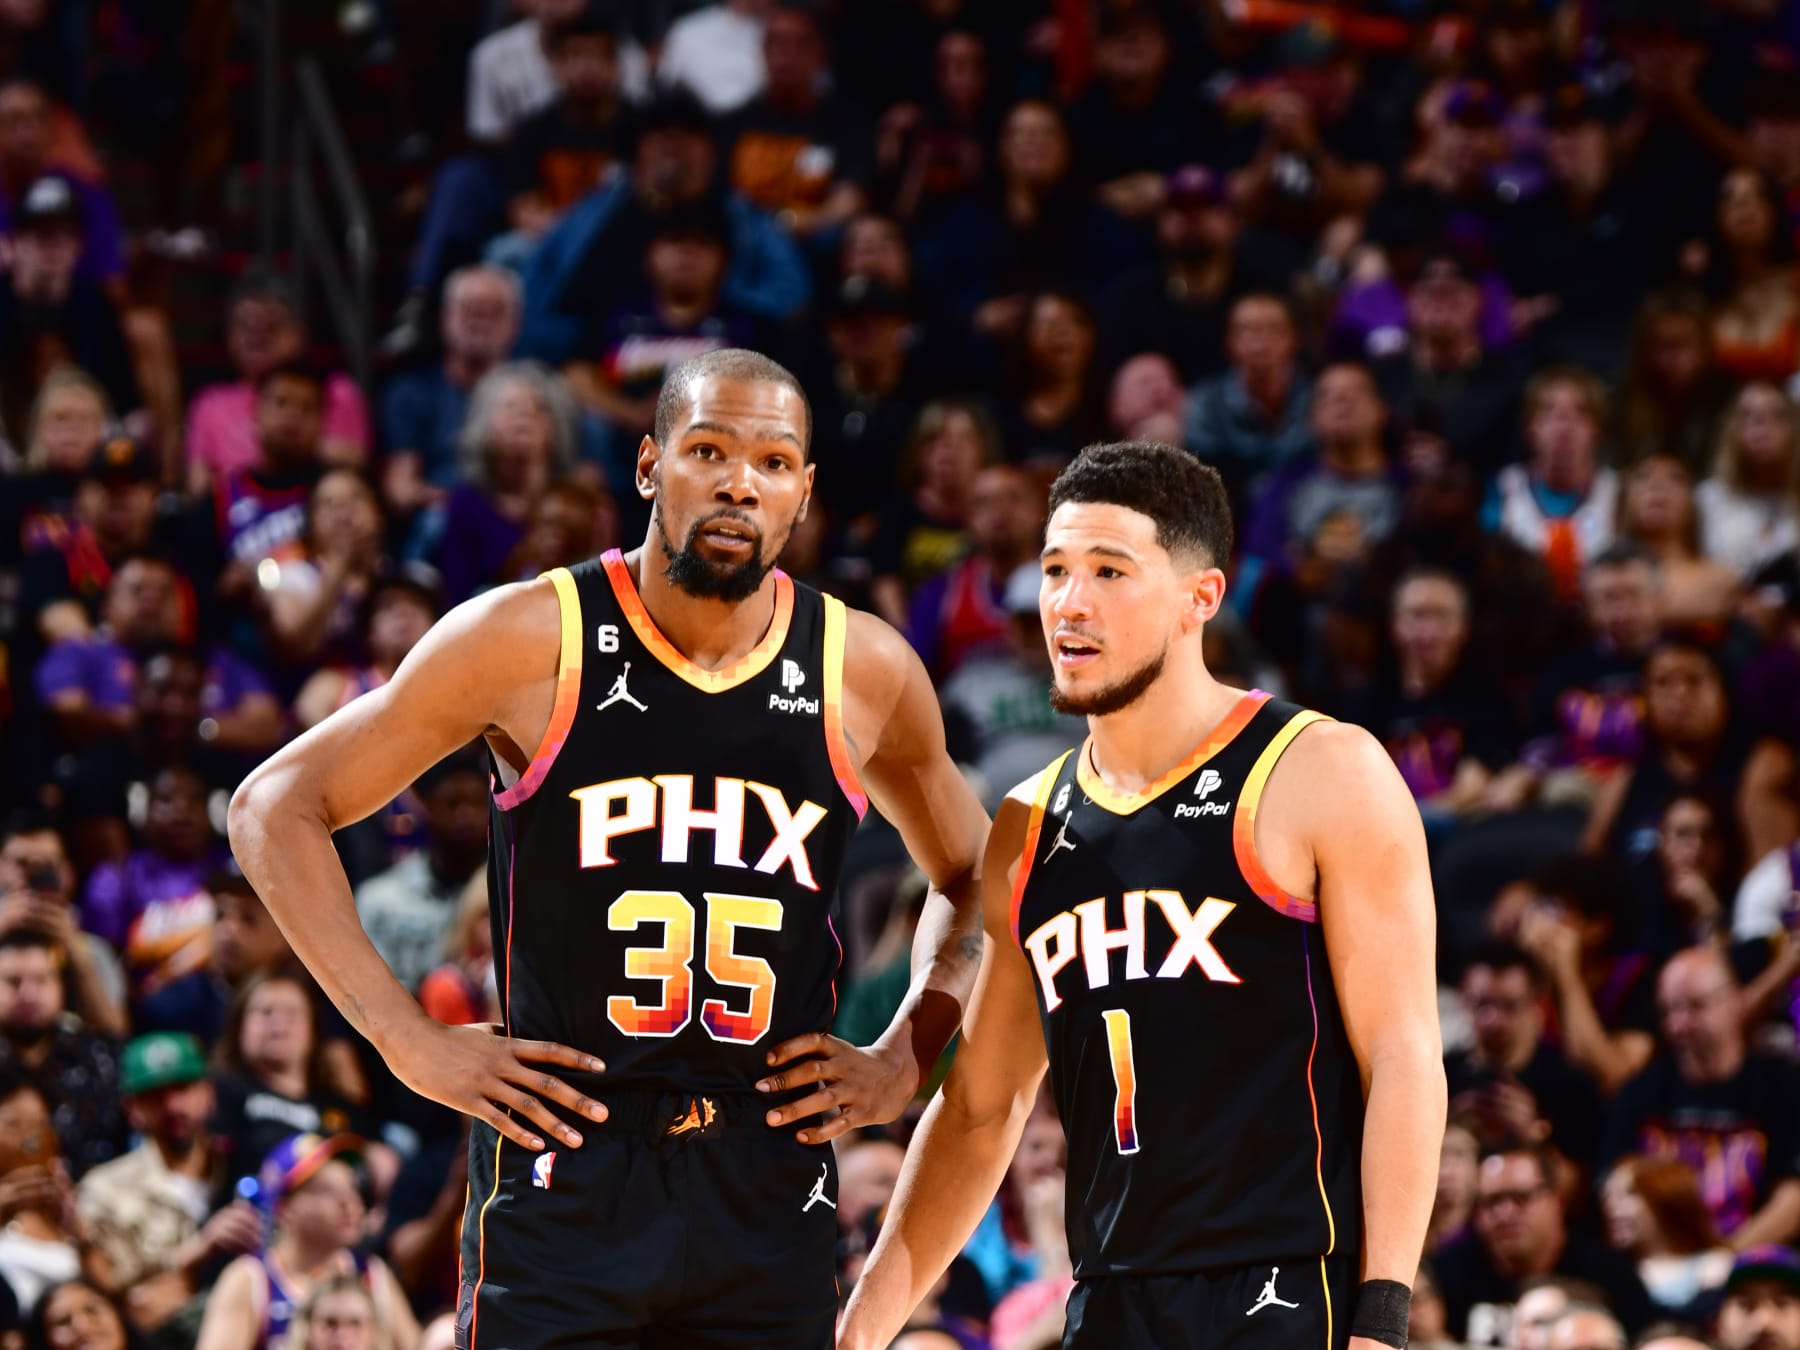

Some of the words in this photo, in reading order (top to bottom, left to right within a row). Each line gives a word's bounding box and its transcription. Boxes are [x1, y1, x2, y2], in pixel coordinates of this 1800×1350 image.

[598, 624, 619, 653] 6
[769, 694, 819, 714] PayPal
[568, 774, 829, 892] PHX
[1053, 784, 1071, 814] 6
[1174, 801, 1231, 819] PayPal
[607, 890, 784, 1045] 35
[1024, 889, 1245, 1013] PHX
[1101, 1009, 1140, 1155] 1
